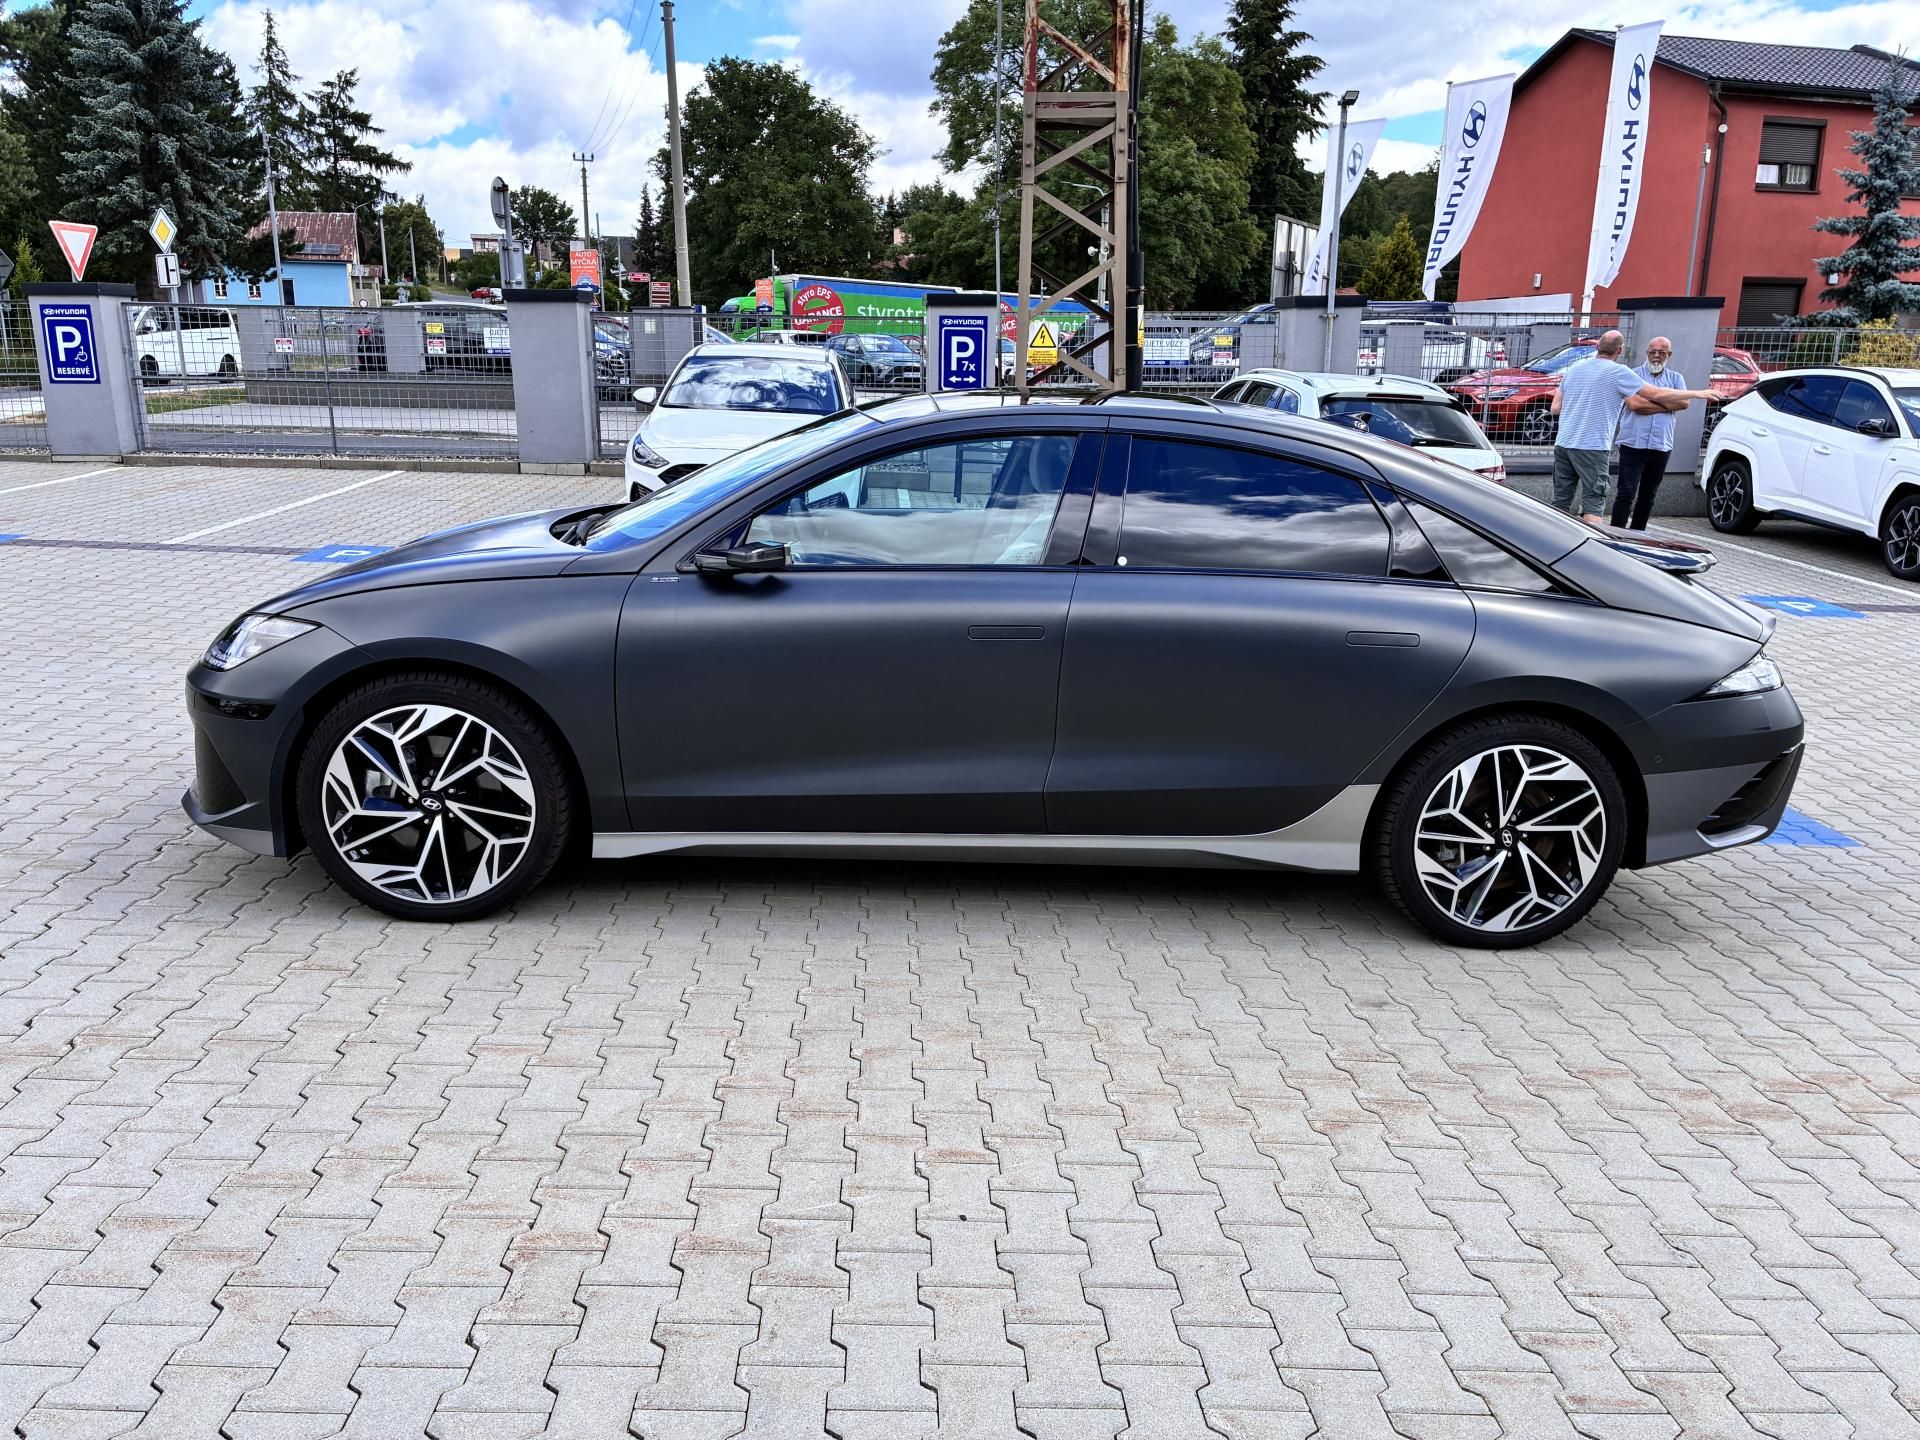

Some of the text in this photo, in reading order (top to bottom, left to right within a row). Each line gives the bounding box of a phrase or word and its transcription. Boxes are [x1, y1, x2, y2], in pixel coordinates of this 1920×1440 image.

[1610, 120, 1640, 262] HYUND
[1426, 156, 1475, 270] HYUNDAI
[797, 286, 832, 306] styro EPS
[55, 326, 82, 362] P
[951, 336, 975, 371] P
[57, 365, 91, 375] RESERVÉ
[961, 361, 976, 371] 7x
